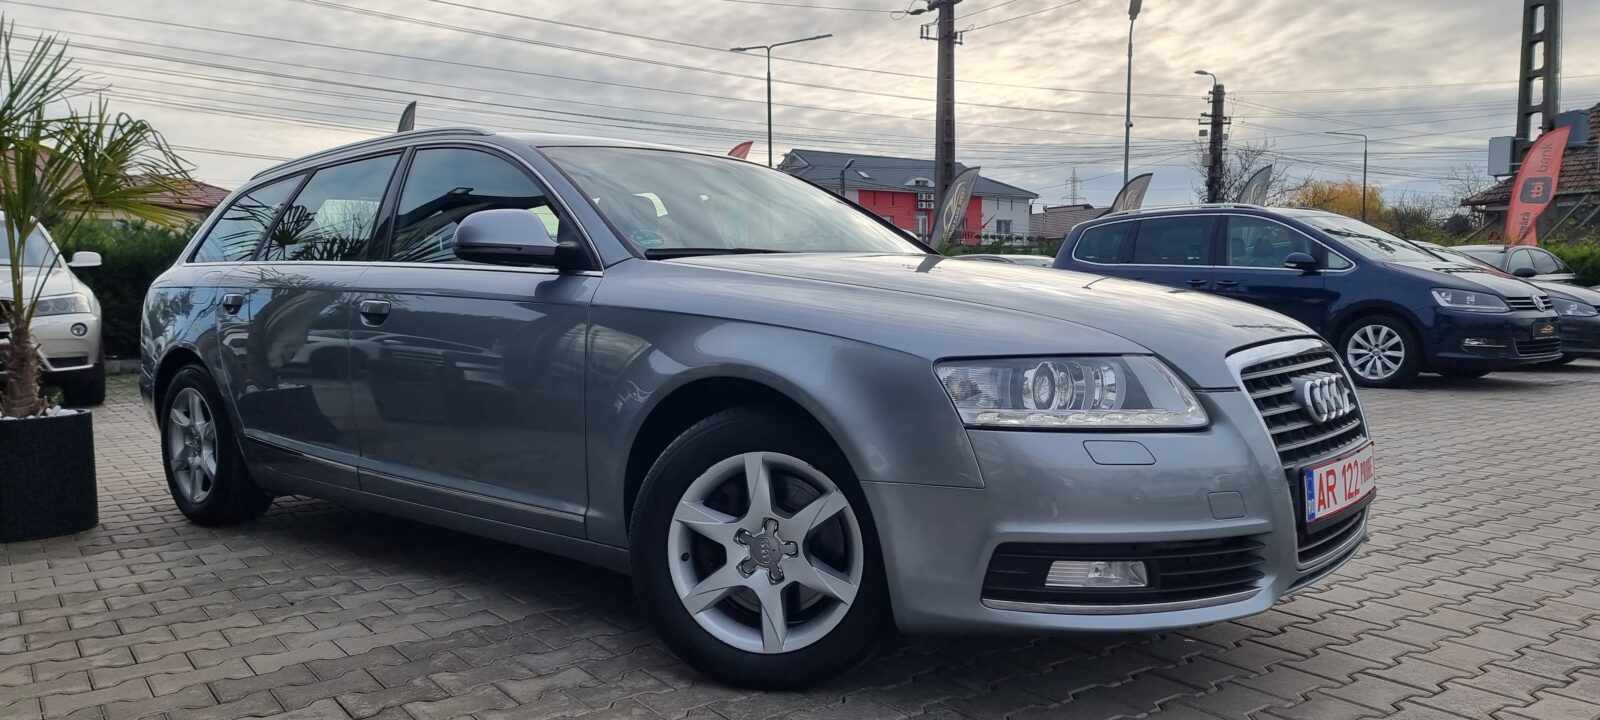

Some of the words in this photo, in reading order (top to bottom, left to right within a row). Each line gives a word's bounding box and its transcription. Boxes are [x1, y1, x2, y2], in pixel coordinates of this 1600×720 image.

[1536, 143, 1553, 173] bank
[1317, 469, 1338, 512] AR
[1342, 459, 1361, 501] 122
